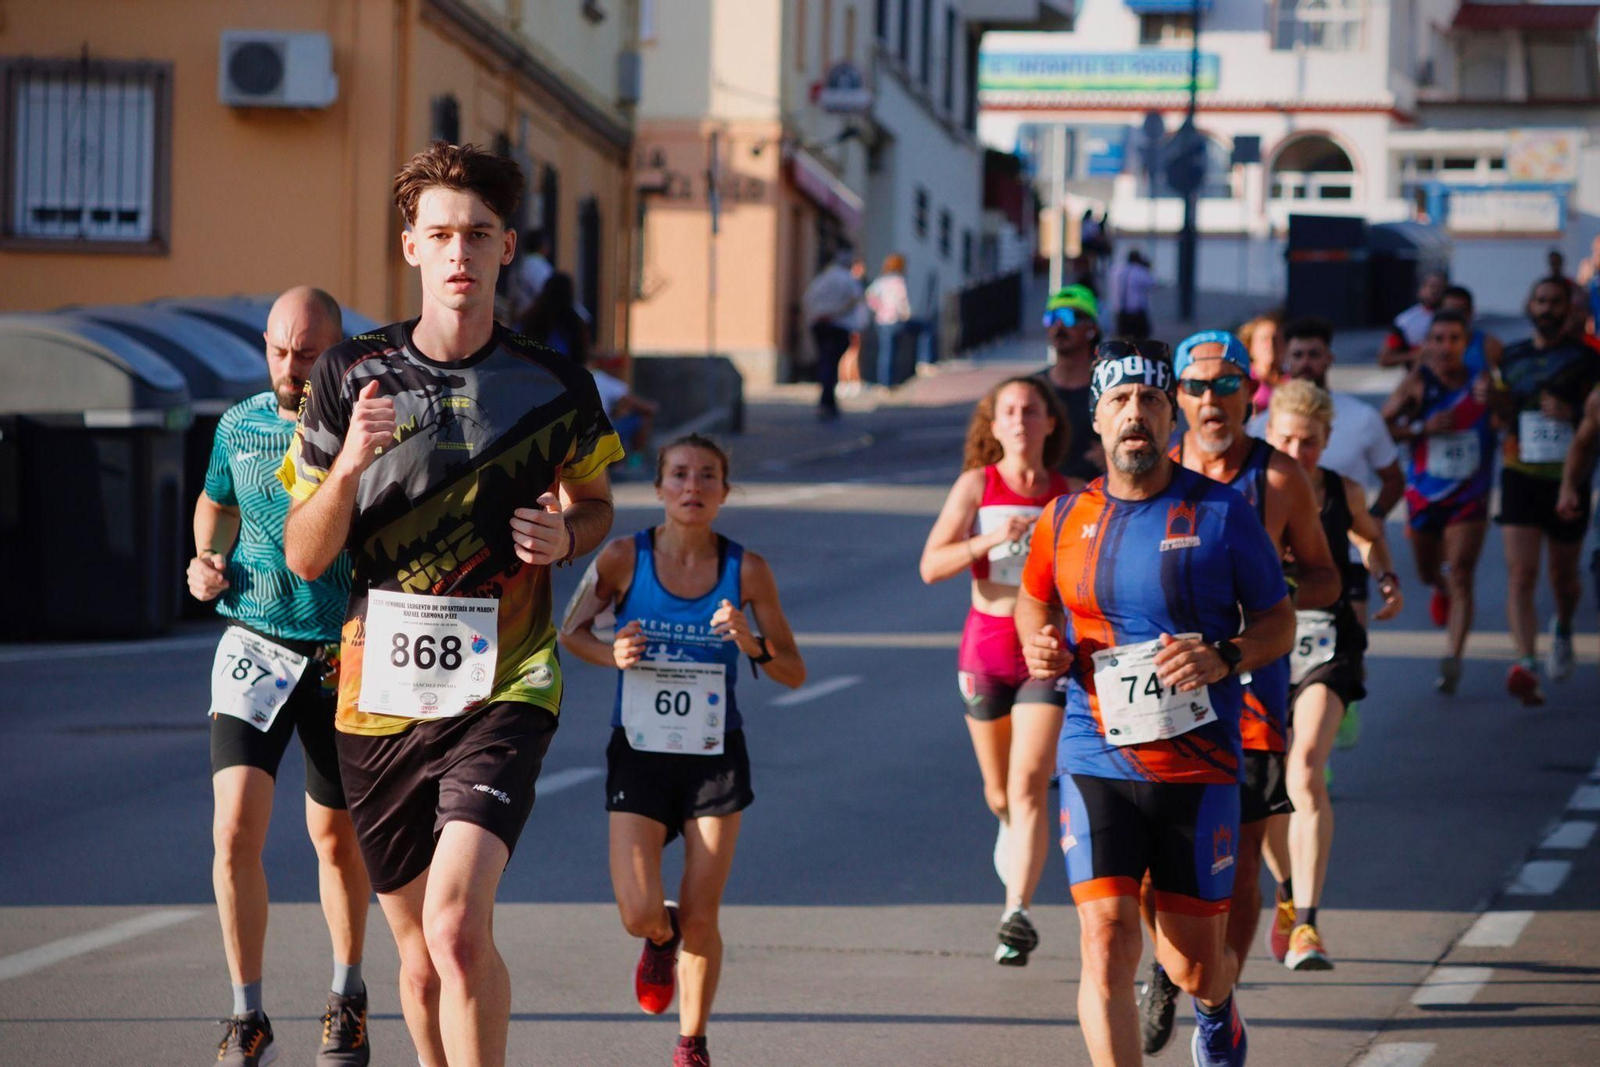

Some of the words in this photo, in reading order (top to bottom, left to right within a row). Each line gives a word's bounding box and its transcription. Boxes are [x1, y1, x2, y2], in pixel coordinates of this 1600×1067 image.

[406, 602, 431, 611] SARGENTO
[420, 611, 444, 619] CARMONA
[390, 632, 463, 671] 868
[220, 654, 273, 687] 787
[655, 690, 691, 716] 60
